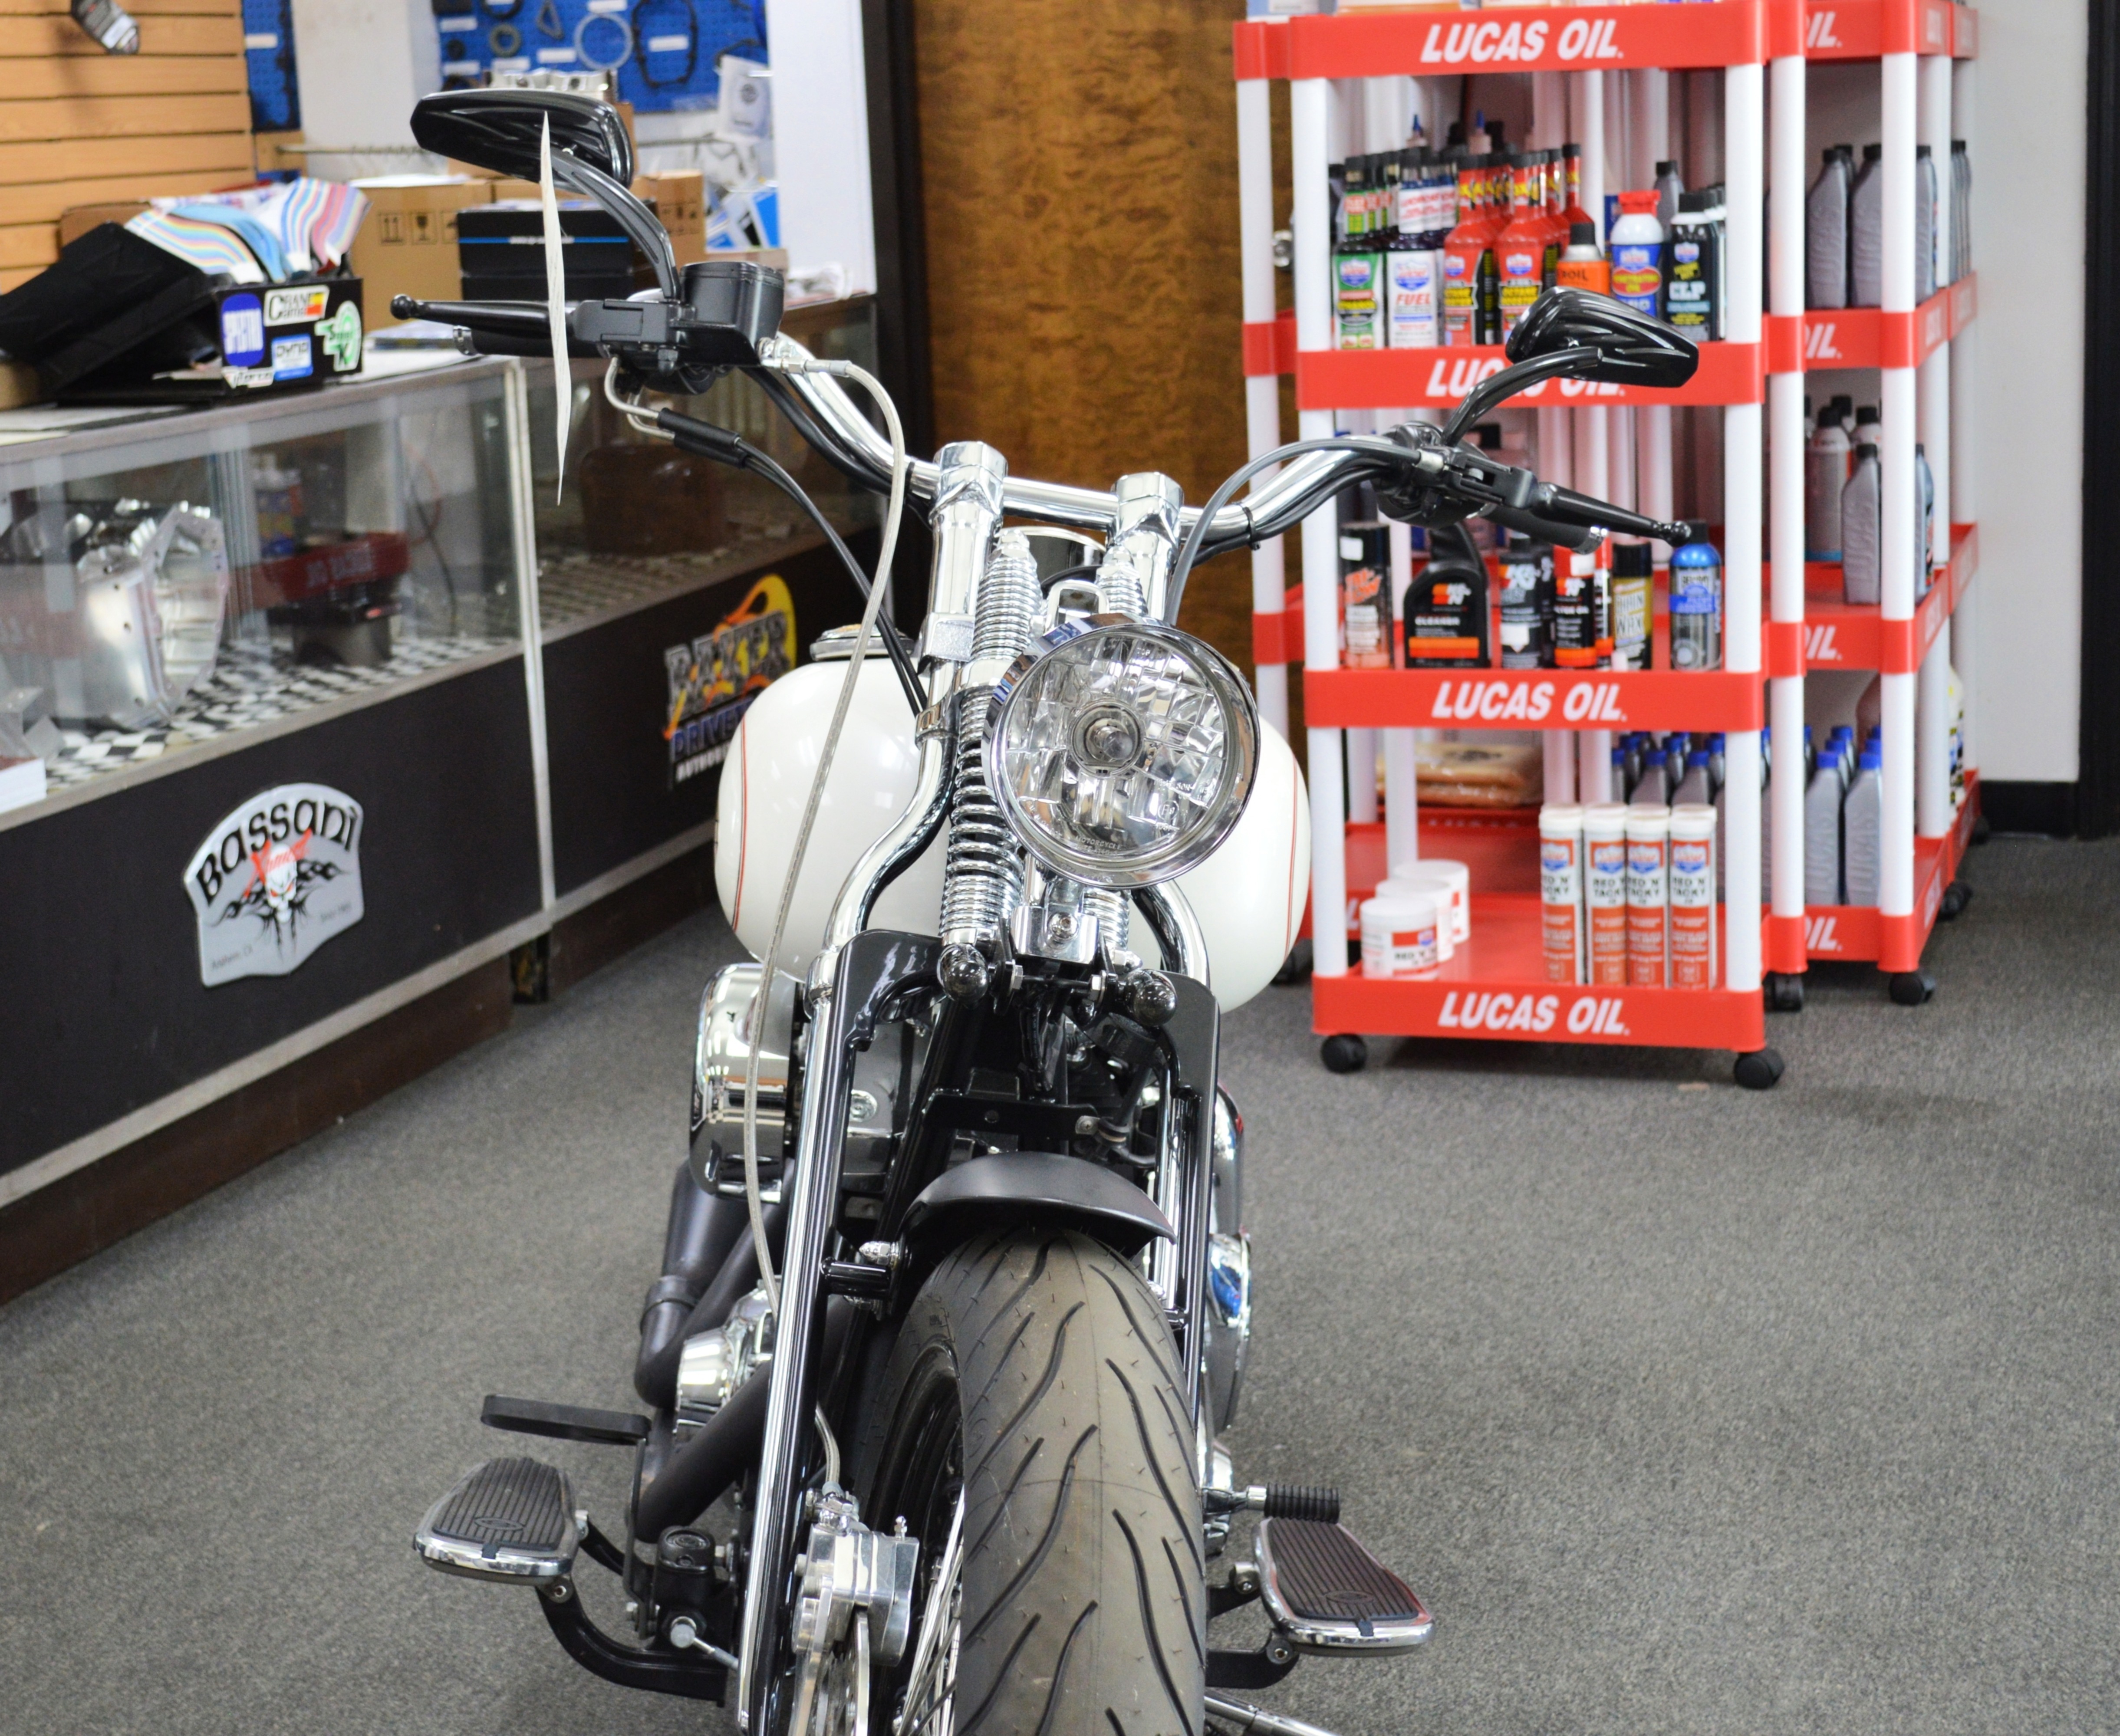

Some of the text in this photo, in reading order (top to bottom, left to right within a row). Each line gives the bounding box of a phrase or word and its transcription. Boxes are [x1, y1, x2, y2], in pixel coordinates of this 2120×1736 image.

[1420, 20, 1549, 63] LUCAS
[1396, 293, 1430, 305] FUEL
[1432, 681, 1555, 720] LUCAS
[196, 799, 359, 907] Bassani
[1076, 835, 1123, 850] MOTORCYCLE
[1437, 991, 1560, 1032] LUCAS
